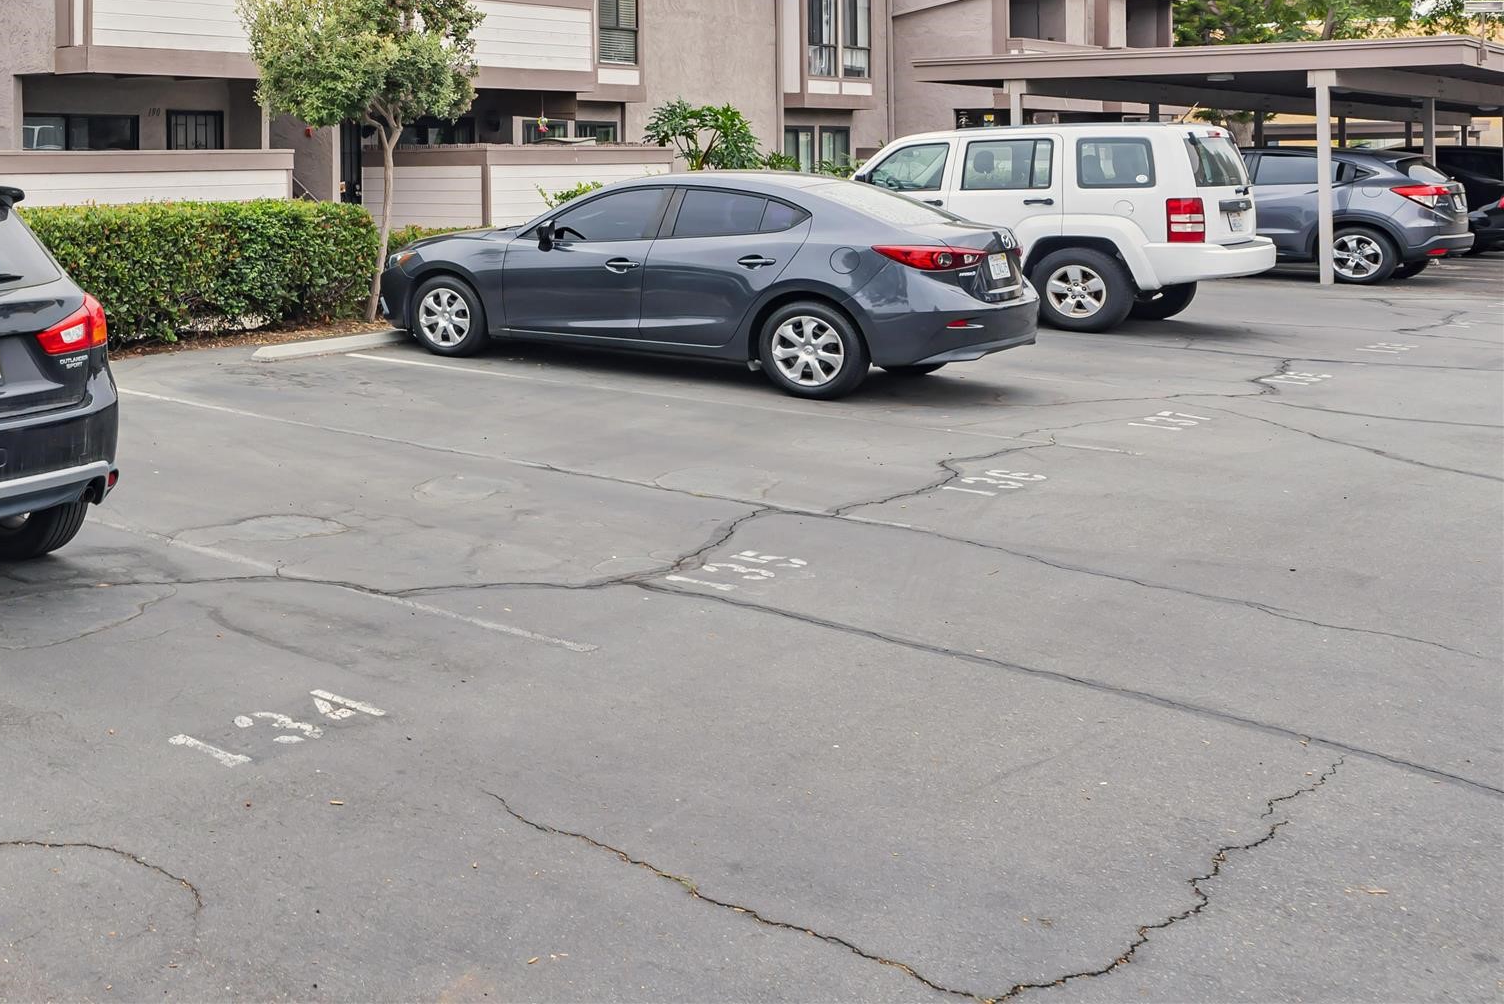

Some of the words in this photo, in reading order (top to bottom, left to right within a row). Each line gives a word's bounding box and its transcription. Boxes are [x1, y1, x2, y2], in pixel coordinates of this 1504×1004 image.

[1127, 410, 1212, 431] 137
[941, 469, 1048, 497] 136
[665, 549, 809, 592] 135
[167, 688, 388, 769] 134
